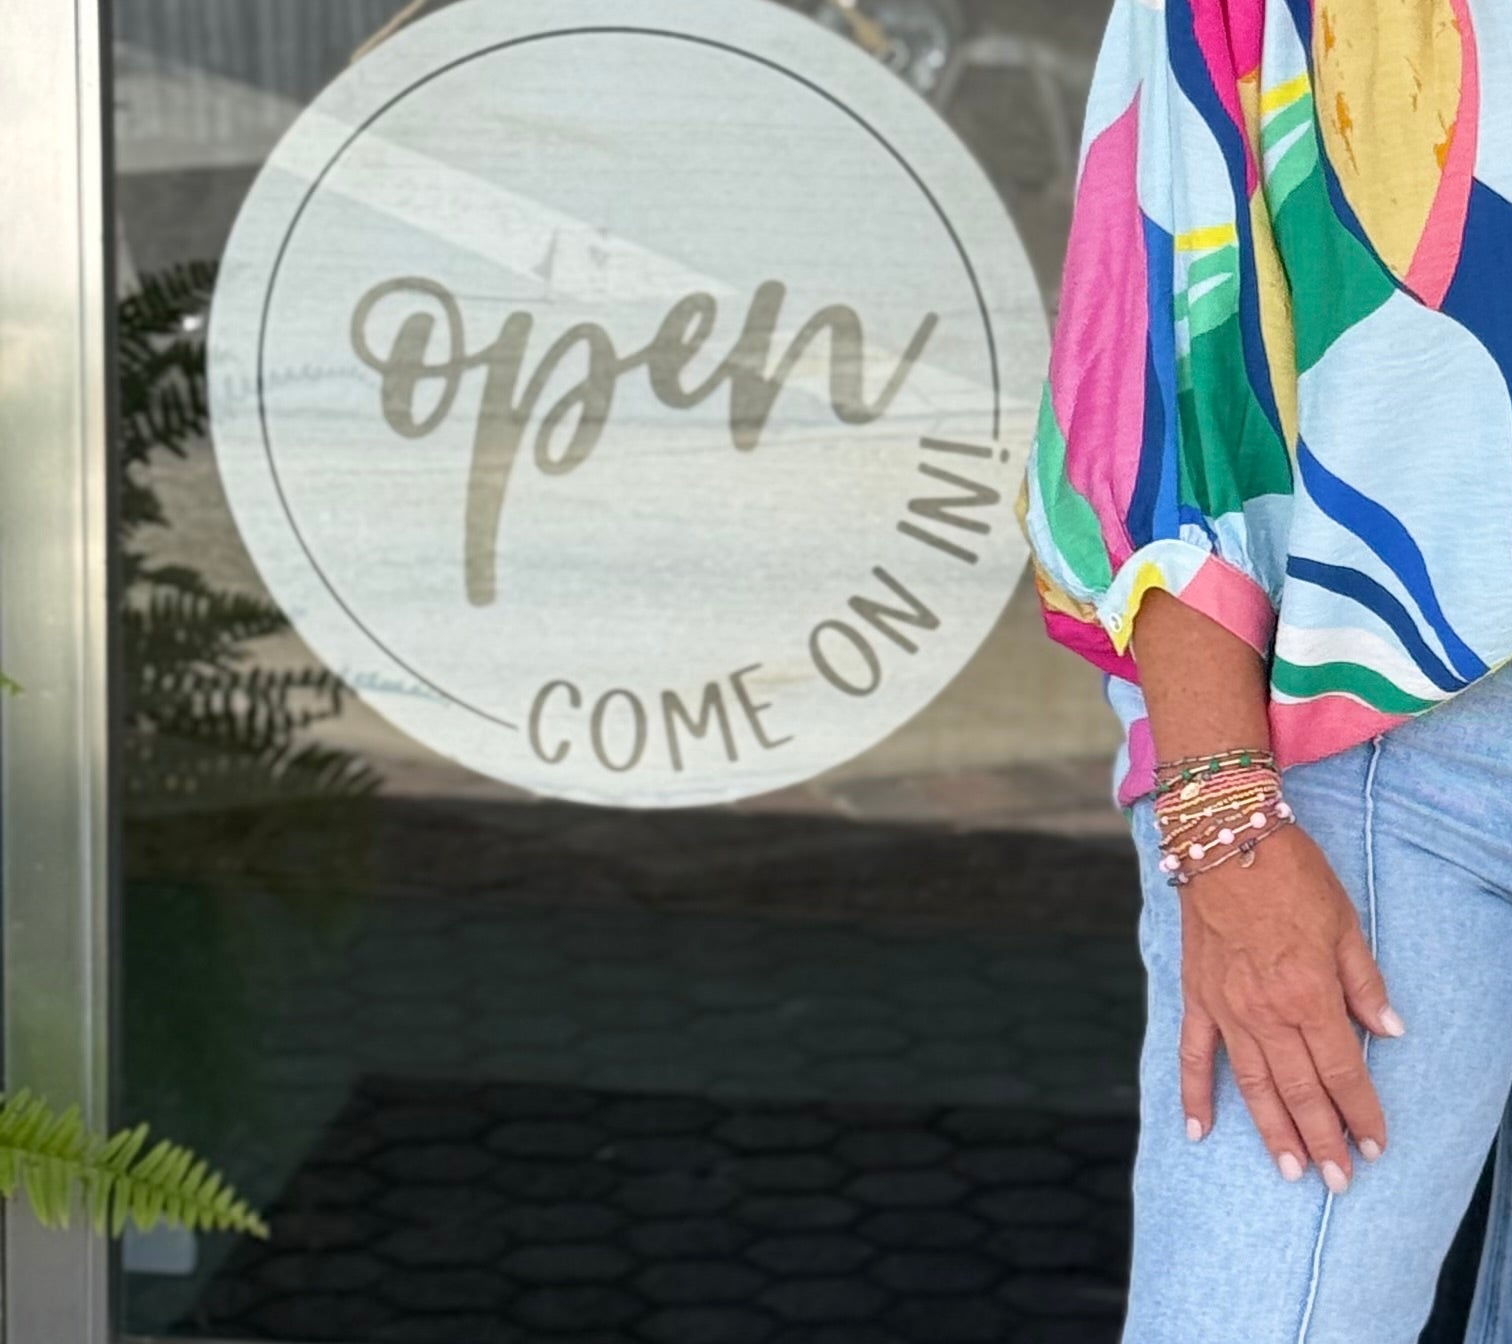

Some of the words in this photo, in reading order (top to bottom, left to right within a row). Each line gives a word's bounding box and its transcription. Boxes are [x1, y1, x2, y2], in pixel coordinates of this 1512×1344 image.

[350, 276, 939, 606] open
[528, 664, 793, 773] COME
[808, 566, 941, 698] ON
[896, 436, 1010, 565] IN!
